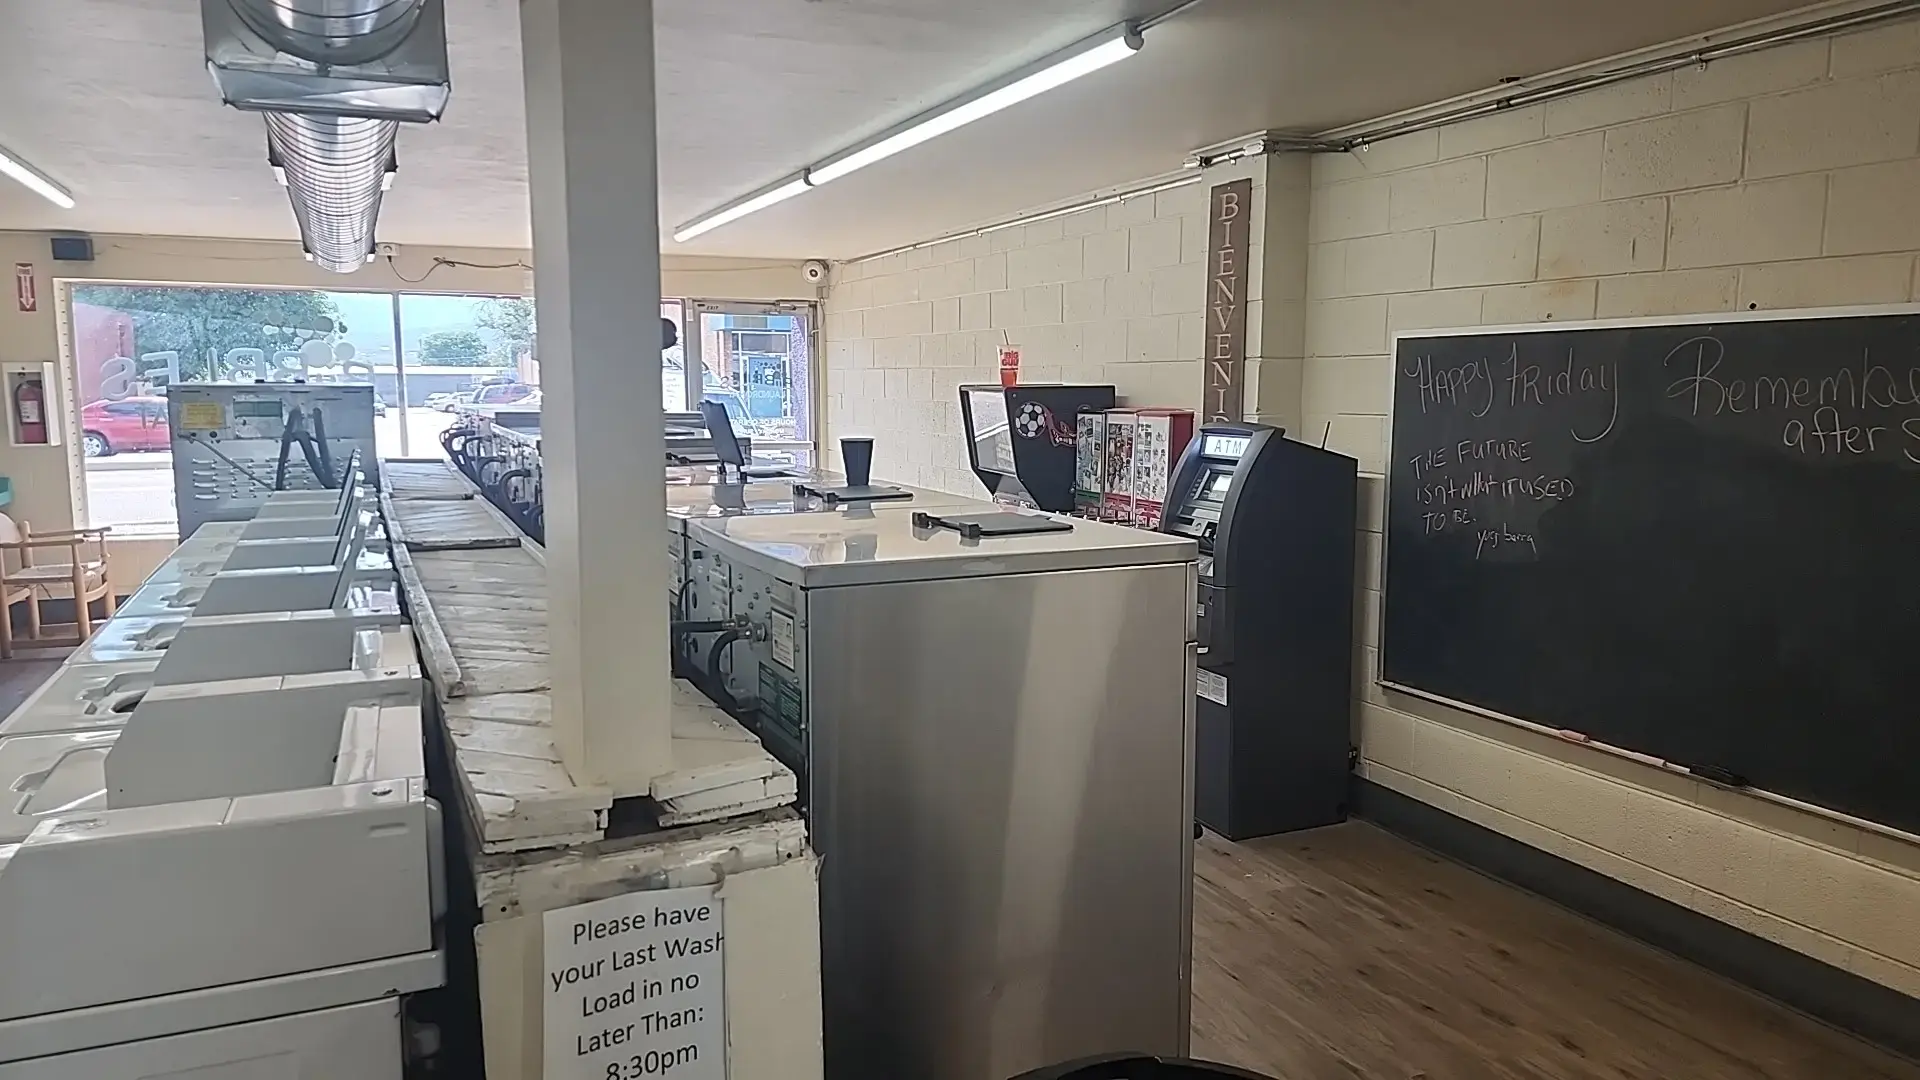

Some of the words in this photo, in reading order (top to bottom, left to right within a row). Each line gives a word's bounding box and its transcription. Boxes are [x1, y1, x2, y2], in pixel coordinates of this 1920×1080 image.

[1214, 439, 1242, 454] ATM
[1783, 406, 1887, 454] after
[1409, 447, 1447, 480] THE
[1457, 439, 1533, 464] FUTURE
[1422, 510, 1447, 534] TO
[573, 914, 646, 945] Please
[654, 905, 711, 928] have
[551, 958, 605, 993] your
[612, 943, 657, 972] Last
[582, 981, 635, 1017] Load
[643, 979, 662, 1000] in
[671, 973, 700, 993] no
[577, 1023, 635, 1056] Later
[641, 1007, 704, 1036] Than:
[606, 1043, 698, 1080] 8:30pm
